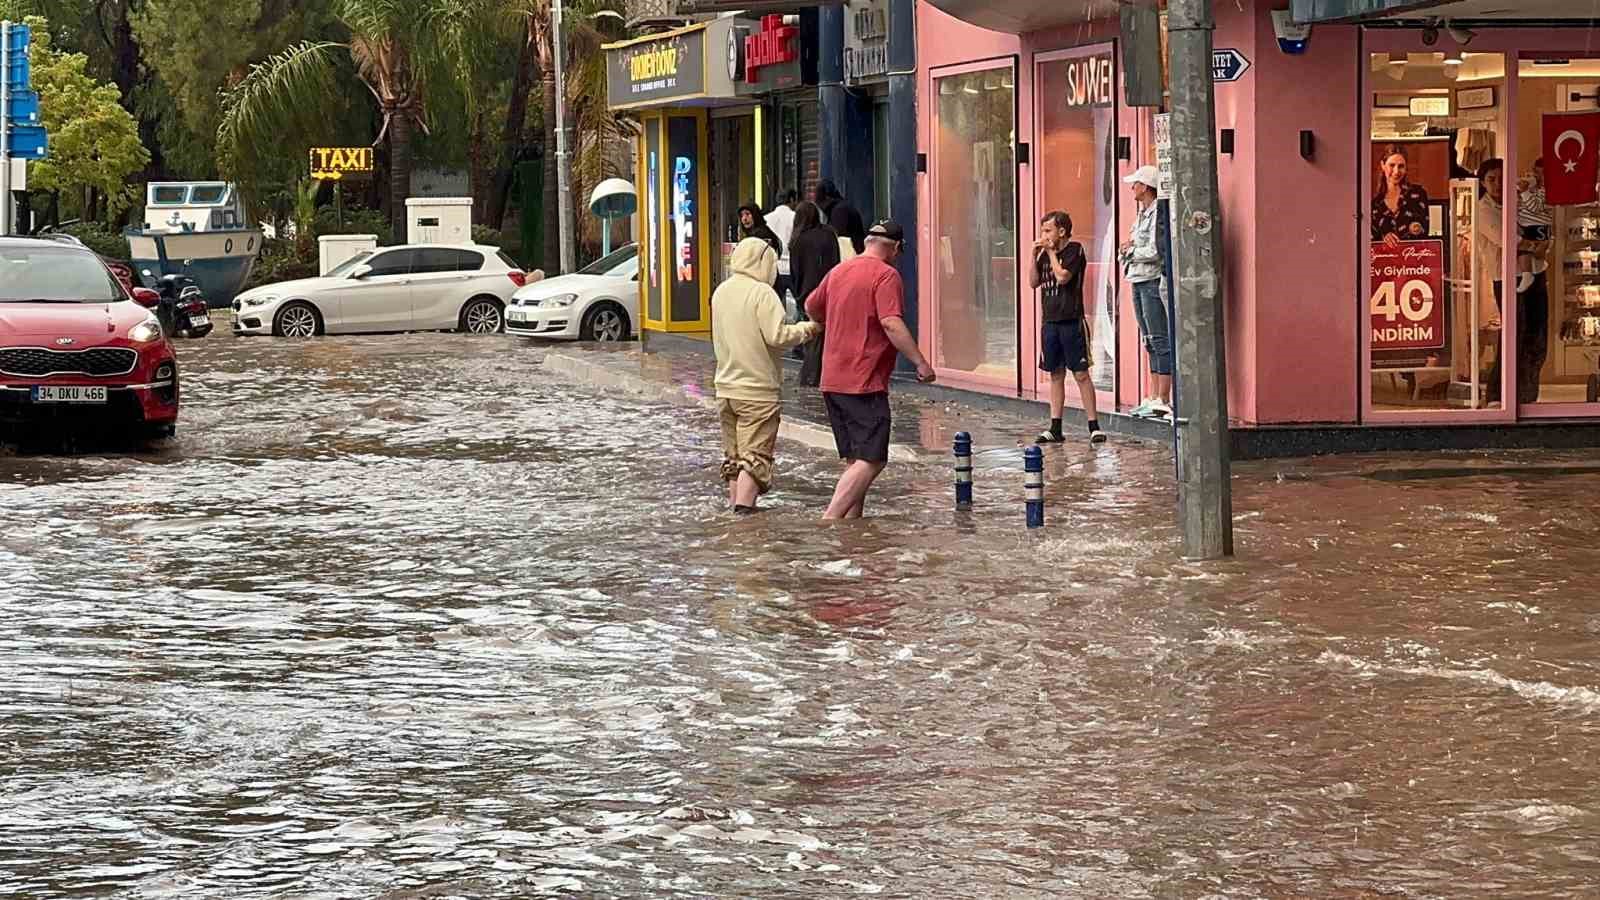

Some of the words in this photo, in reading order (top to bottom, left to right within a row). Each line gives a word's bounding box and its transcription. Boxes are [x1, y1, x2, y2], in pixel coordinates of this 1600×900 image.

[745, 14, 788, 84] public
[317, 148, 365, 168] TAXI
[1384, 264, 1430, 278] Giyimde
[1370, 280, 1433, 321] 40
[1371, 323, 1433, 342] NDİRİM
[40, 388, 53, 399] 34
[84, 388, 104, 399] 466
